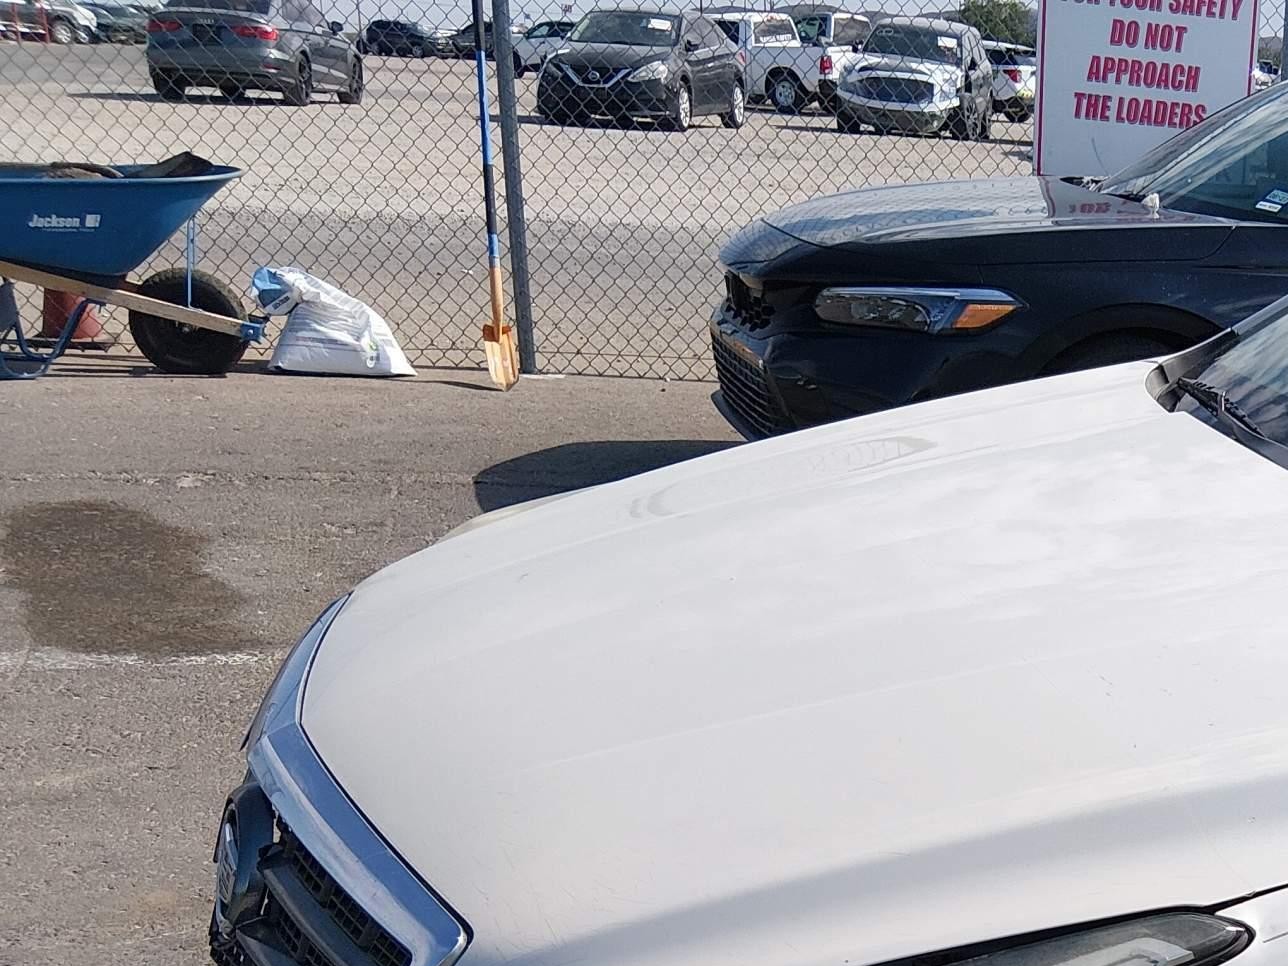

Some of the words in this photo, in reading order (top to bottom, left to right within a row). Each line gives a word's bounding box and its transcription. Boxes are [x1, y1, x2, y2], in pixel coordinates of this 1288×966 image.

[1109, 18, 1140, 48] DO
[1144, 22, 1188, 53] NOT
[1086, 55, 1201, 92] APPROACH
[1073, 91, 1112, 121] THE
[1115, 96, 1207, 129] LOADERS
[27, 214, 81, 228] Jackson
